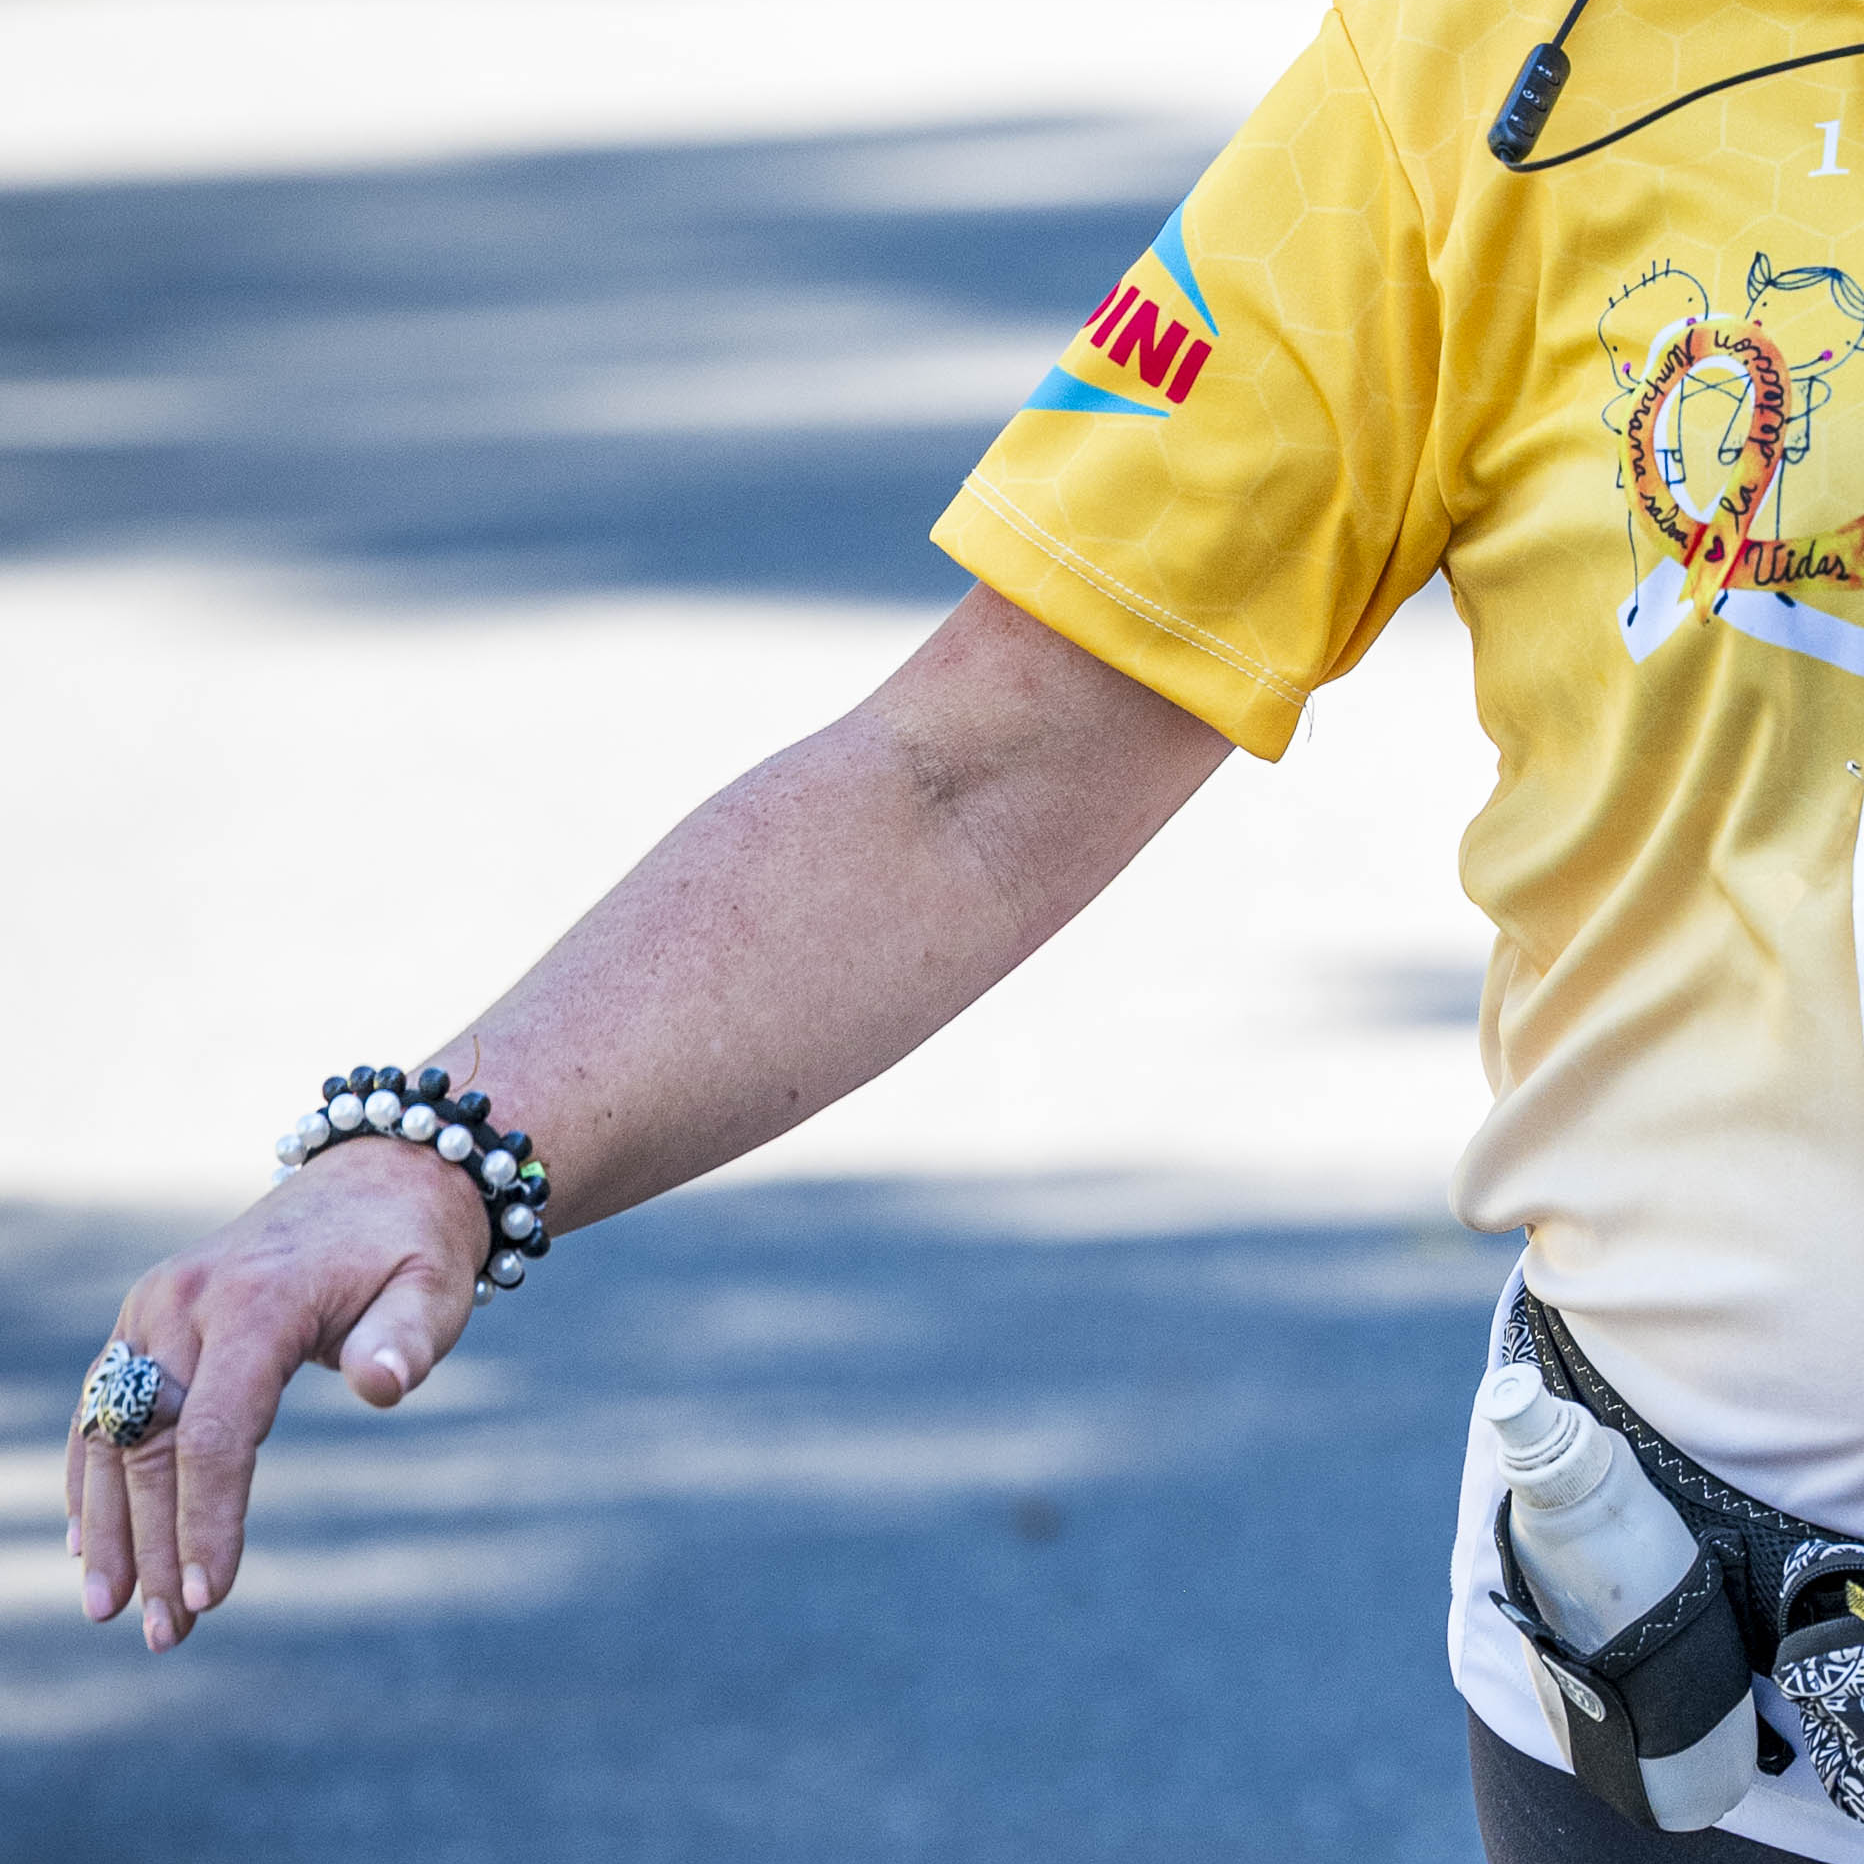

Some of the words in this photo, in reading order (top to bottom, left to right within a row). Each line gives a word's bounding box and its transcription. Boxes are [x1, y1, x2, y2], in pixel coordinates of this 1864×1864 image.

[1083, 280, 1213, 405] INI
[1628, 328, 1696, 483] temprana
[1639, 491, 1690, 550] salva
